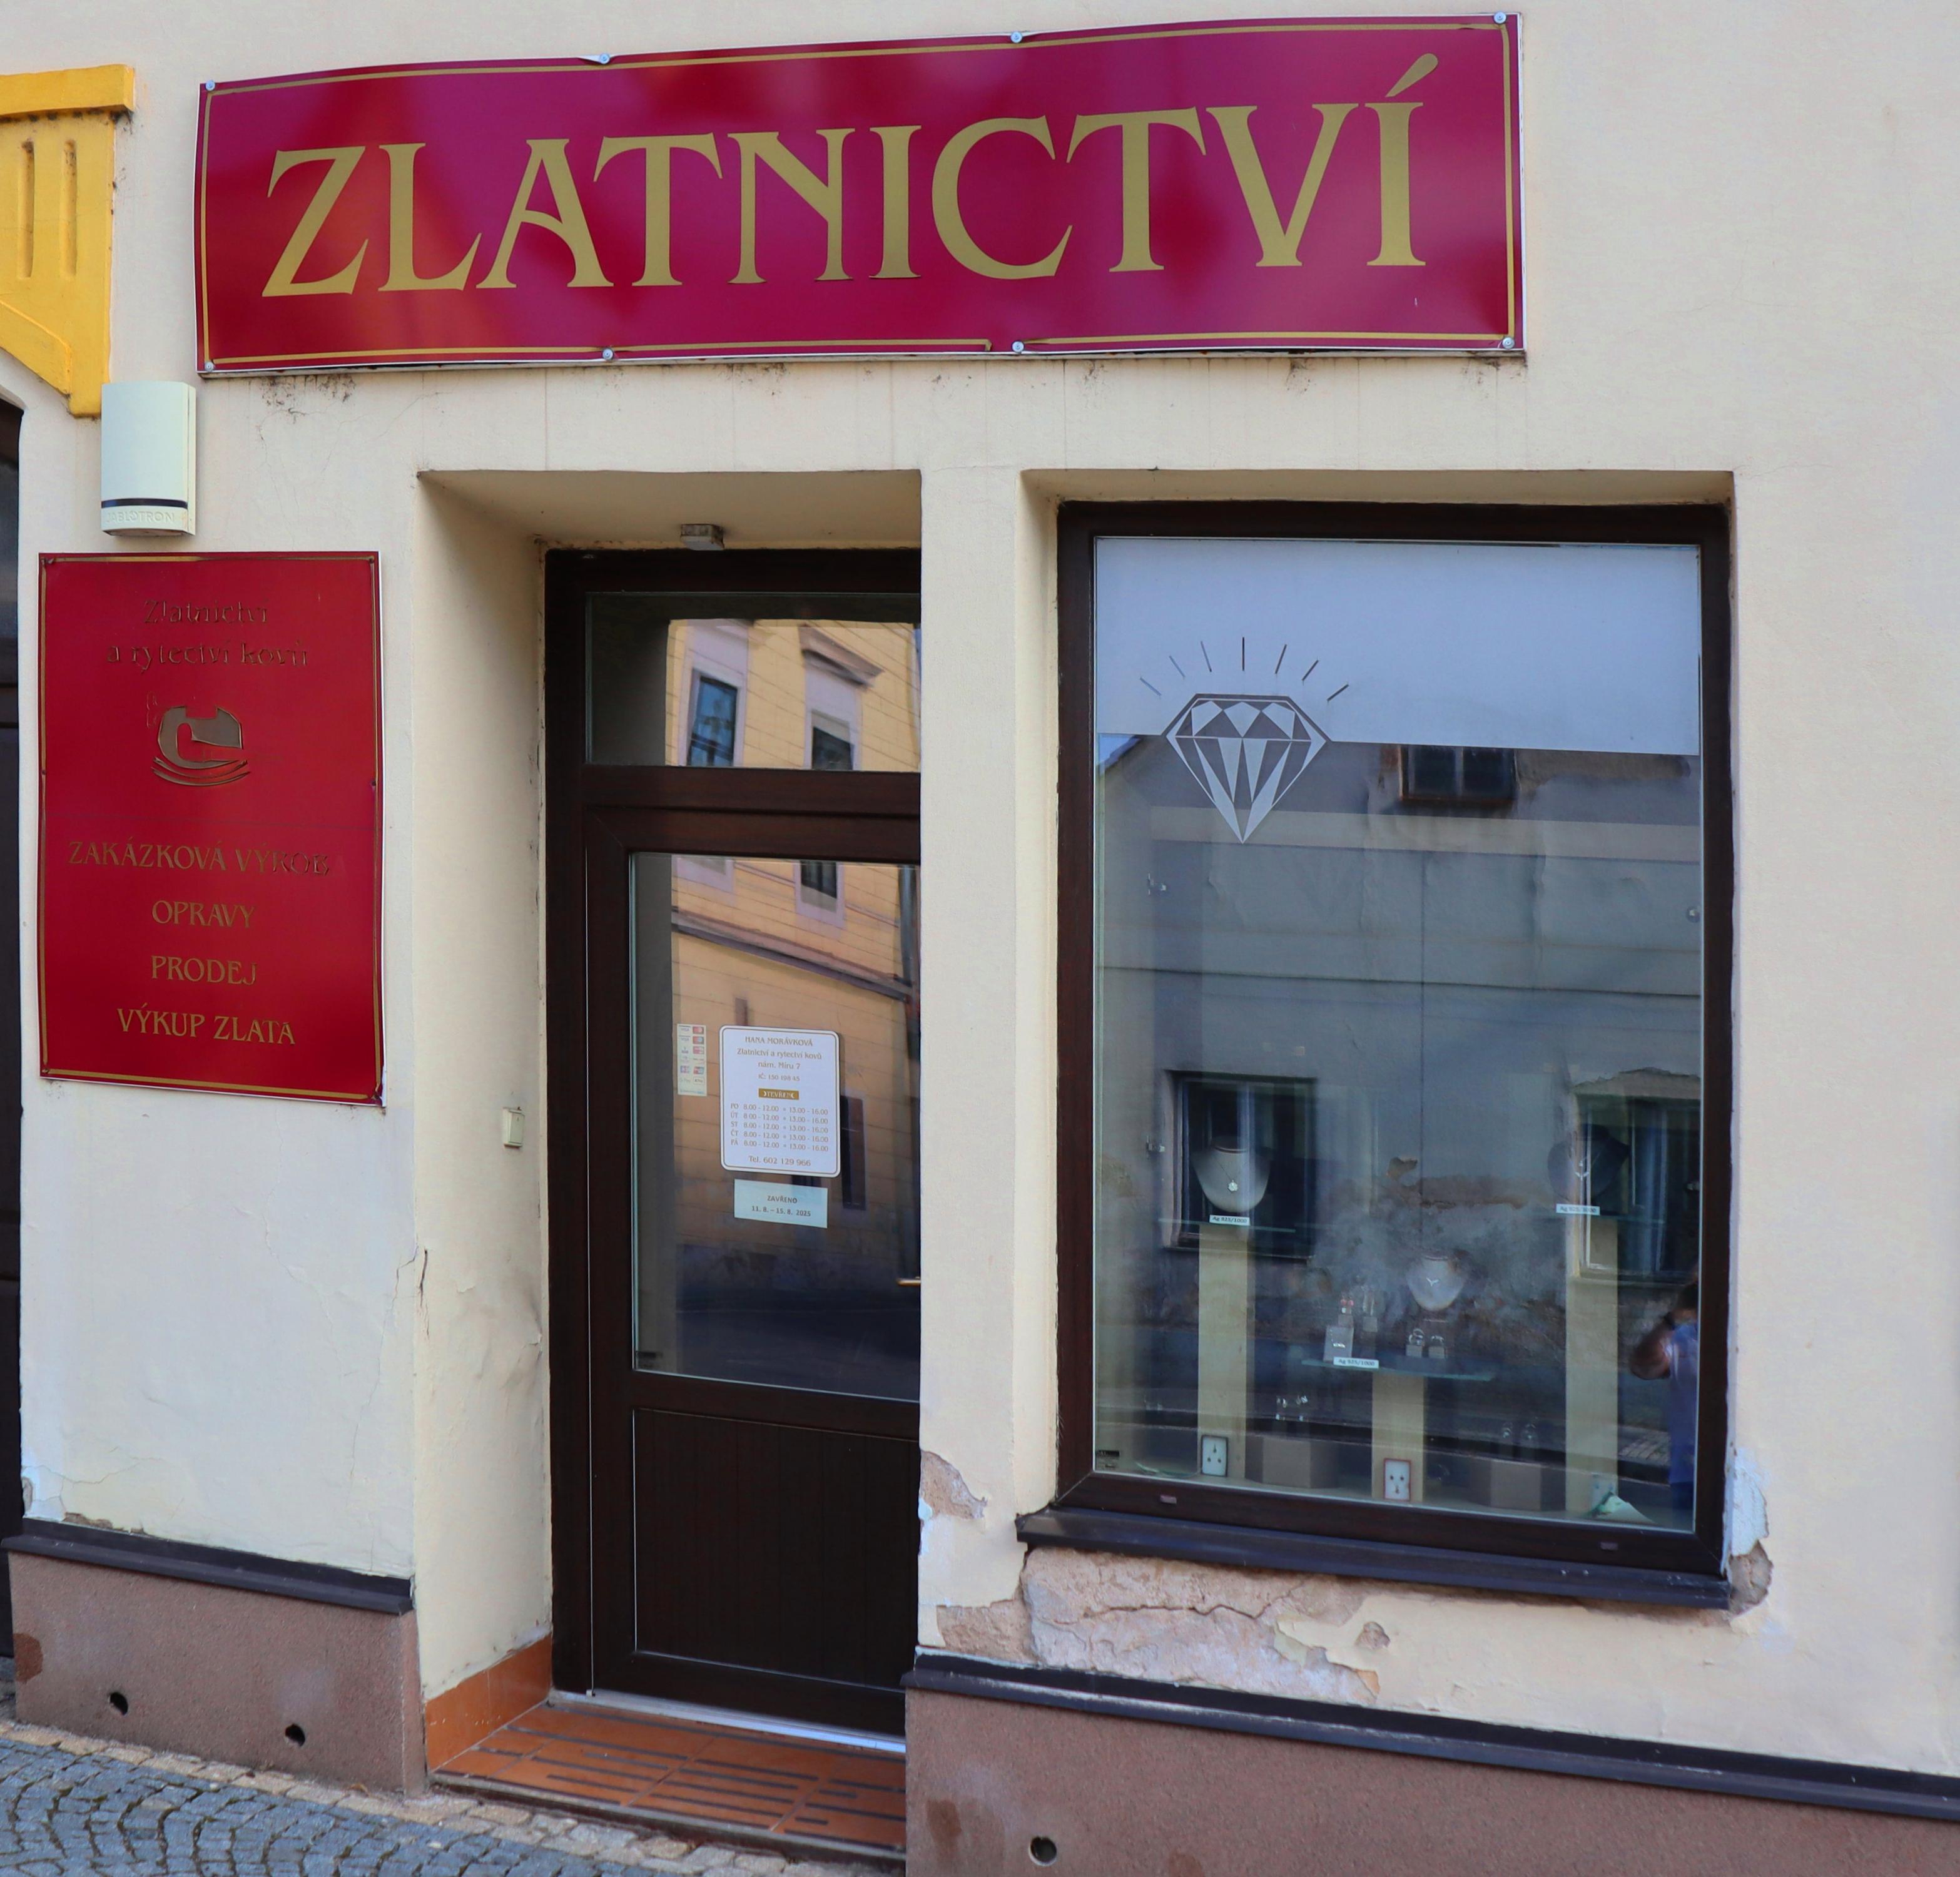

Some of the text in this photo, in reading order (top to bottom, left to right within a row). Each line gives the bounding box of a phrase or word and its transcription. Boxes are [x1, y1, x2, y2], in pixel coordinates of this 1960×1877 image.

[262, 53, 1439, 297] ZLATNICTVÍ
[143, 598, 270, 624] Zlatnictví
[106, 644, 121, 664] a
[68, 837, 348, 877] ZAKÁZKOVÁ VÝROB
[151, 900, 256, 928] OPRAVY
[151, 955, 258, 986] PRODEJ
[116, 1003, 296, 1045] VÝKUP ZLATA
[737, 1048, 769, 1057] Zlatnictví
[745, 1036, 813, 1047] HANA MORÁVKOVÁ
[767, 1194, 798, 1204] ZAVŘENO
